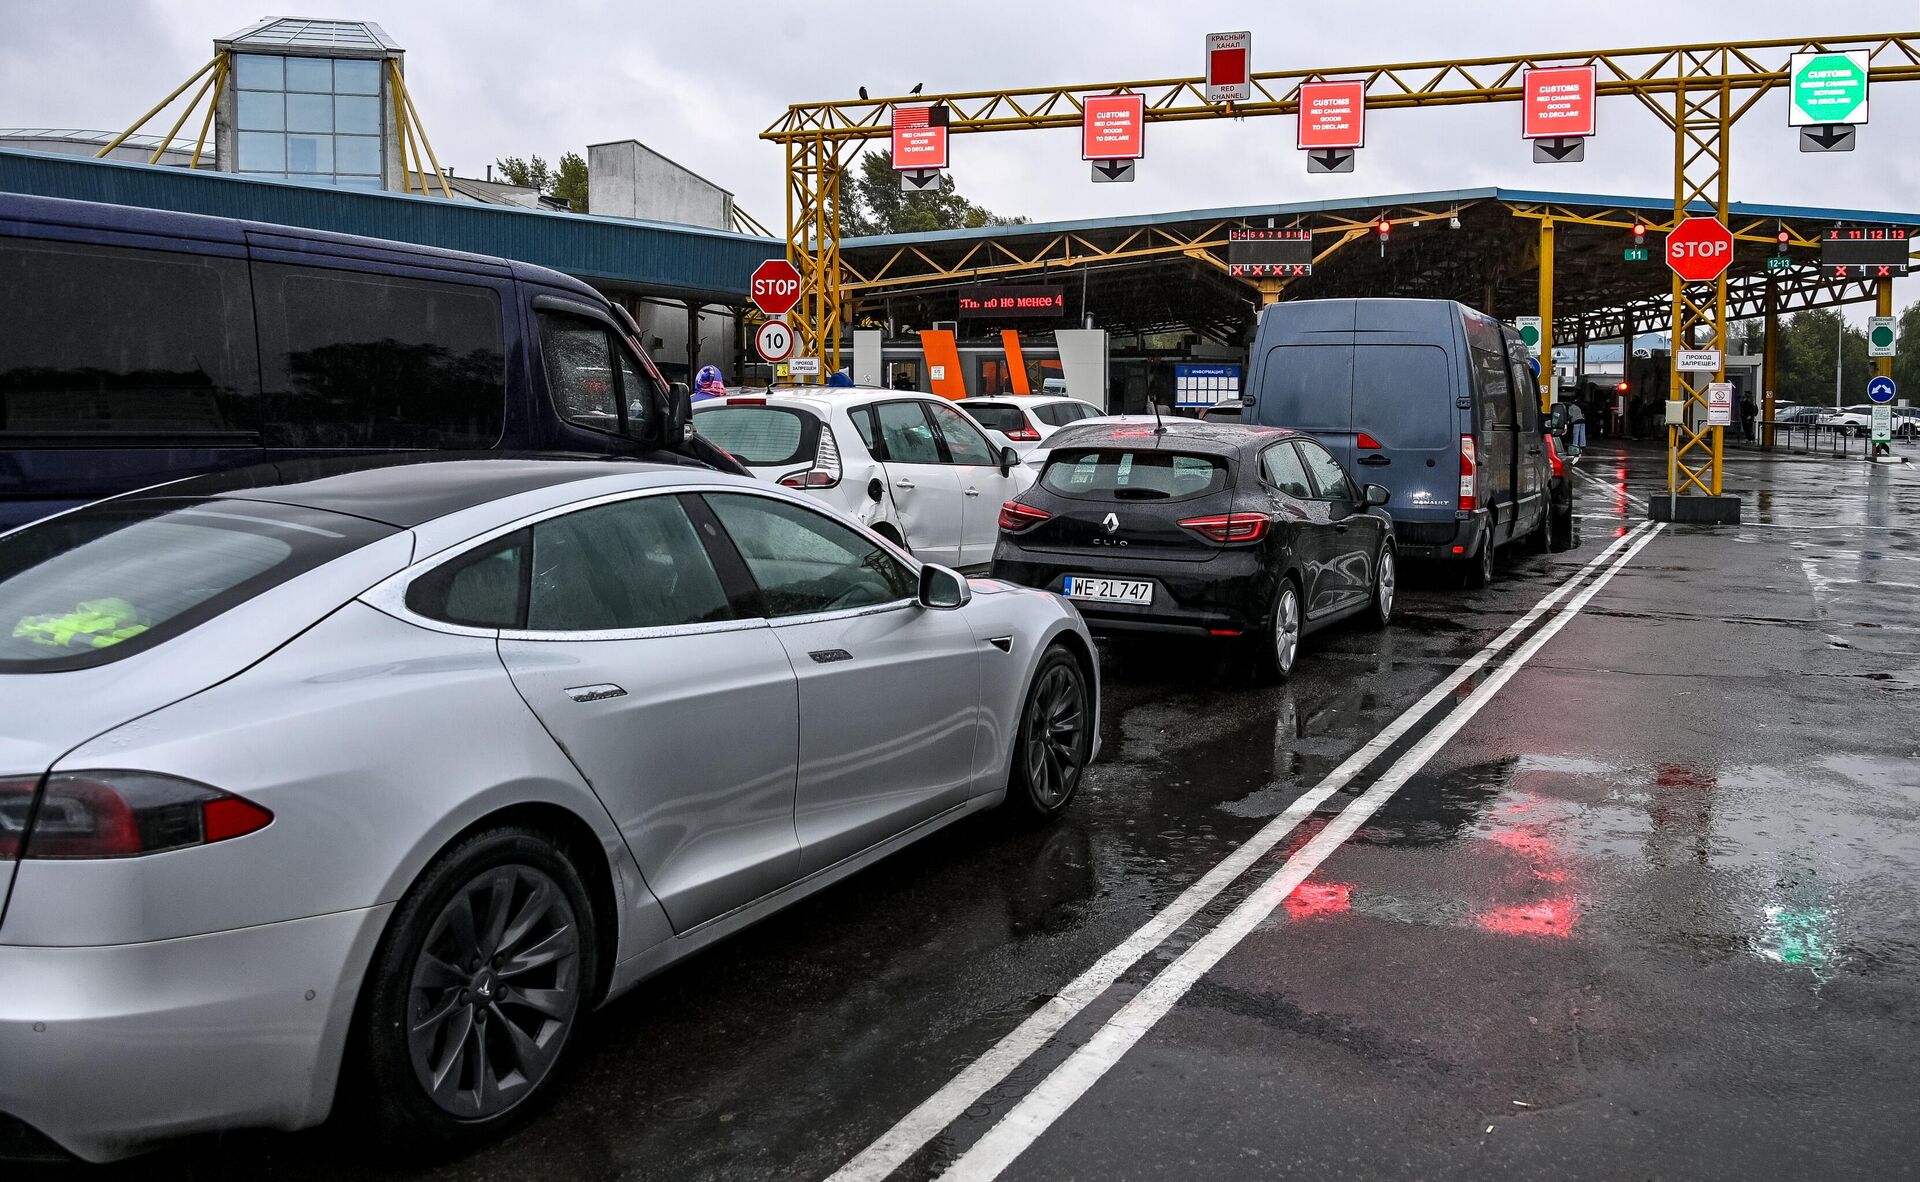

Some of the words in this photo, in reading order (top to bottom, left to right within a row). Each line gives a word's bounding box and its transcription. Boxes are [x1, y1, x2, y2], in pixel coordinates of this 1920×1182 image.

[1212, 34, 1245, 42] КРАСНЫЙ
[1539, 85, 1579, 93] CUSTOMS
[1313, 98, 1349, 106] CUSTOMS
[1849, 231, 1861, 239] 11
[1871, 230, 1883, 239] 12
[1892, 230, 1904, 238] 13
[1672, 241, 1728, 258] STOP
[1631, 250, 1641, 259] 11
[1769, 260, 1790, 268] 12-13
[755, 279, 797, 295] STOP
[1000, 298, 1014, 307] не
[1018, 297, 1052, 307] менее
[1055, 294, 1062, 306] 4
[766, 333, 783, 349] 10
[1074, 579, 1094, 596] WE
[1100, 581, 1148, 599] 2L747
